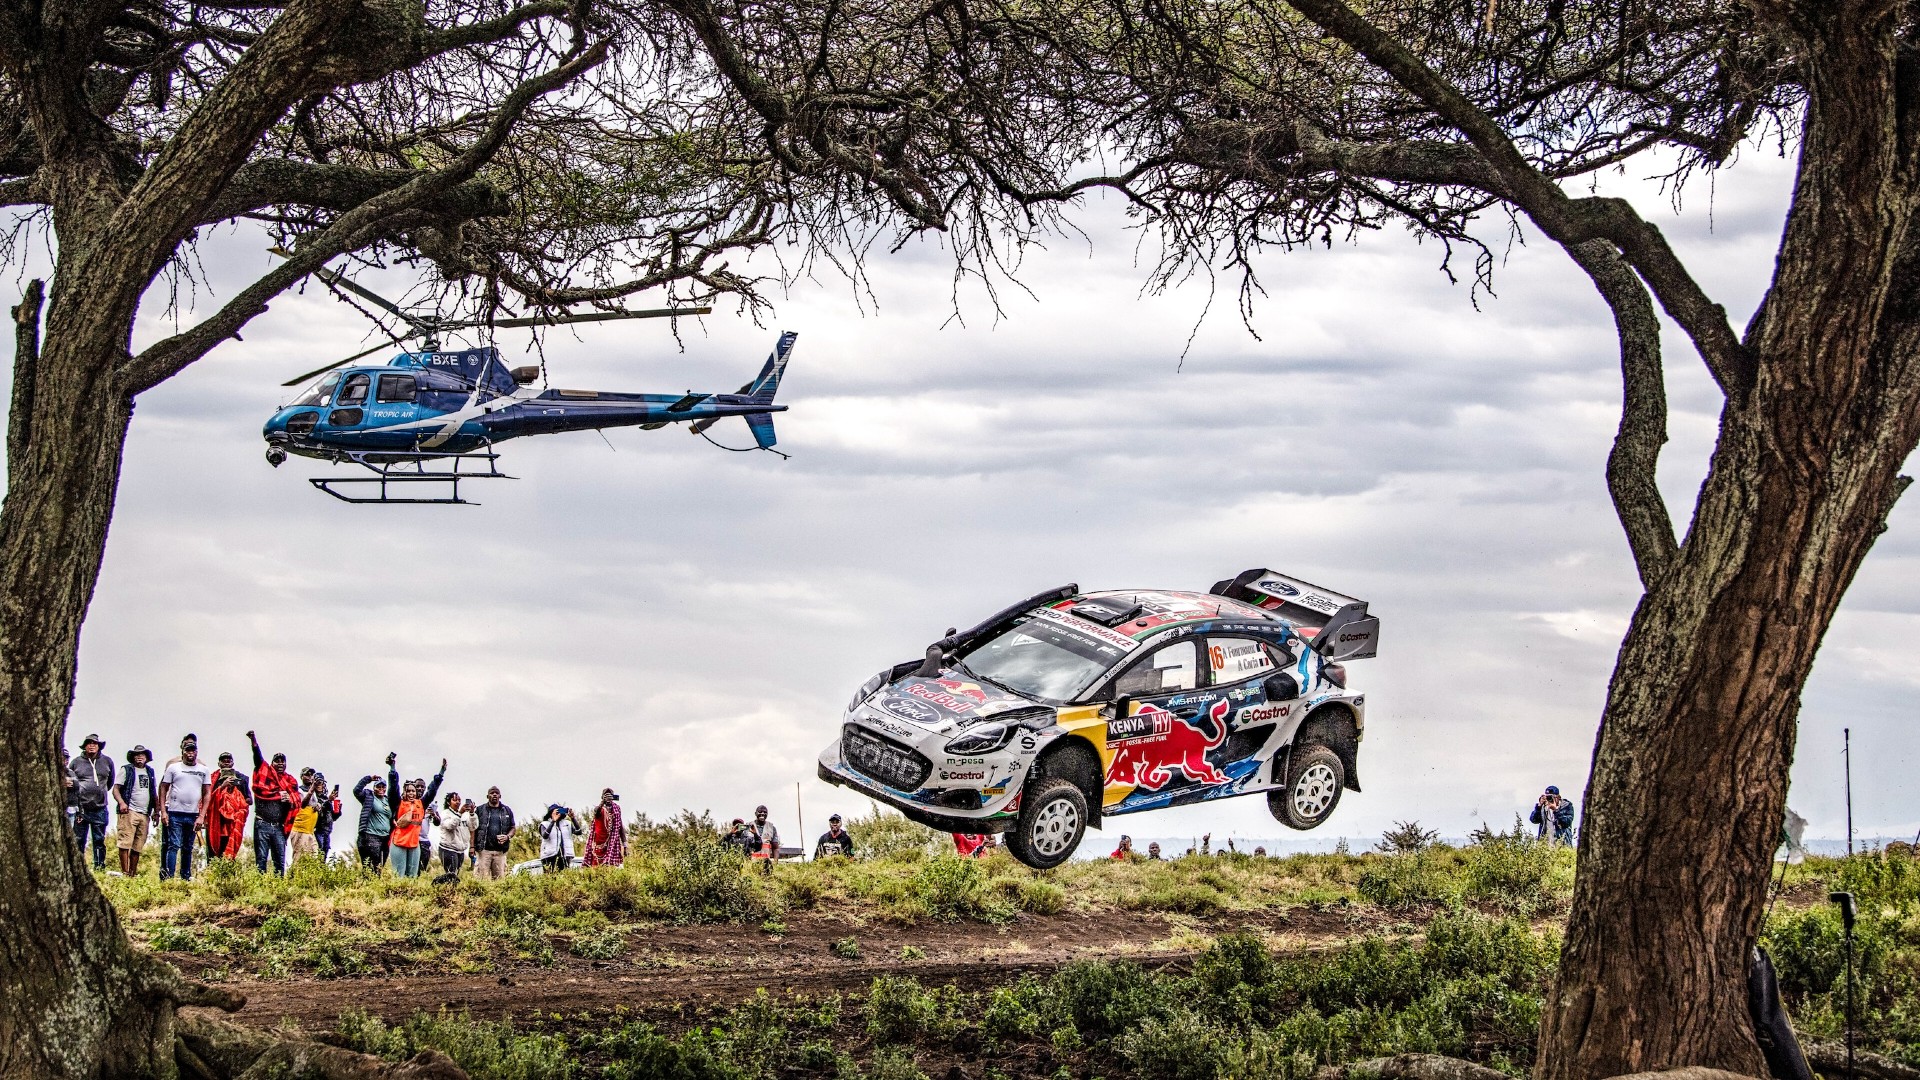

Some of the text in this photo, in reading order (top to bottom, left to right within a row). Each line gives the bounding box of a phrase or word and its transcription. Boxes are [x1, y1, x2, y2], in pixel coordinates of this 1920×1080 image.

[1209, 645, 1224, 670] 16
[888, 700, 933, 720] Ford
[1252, 704, 1291, 721] Castrol
[1108, 713, 1169, 735] KENYA HY
[1126, 736, 1155, 746] FOSSIL-FREE
[1155, 734, 1167, 742] FUEL
[949, 771, 985, 780] Castrol
